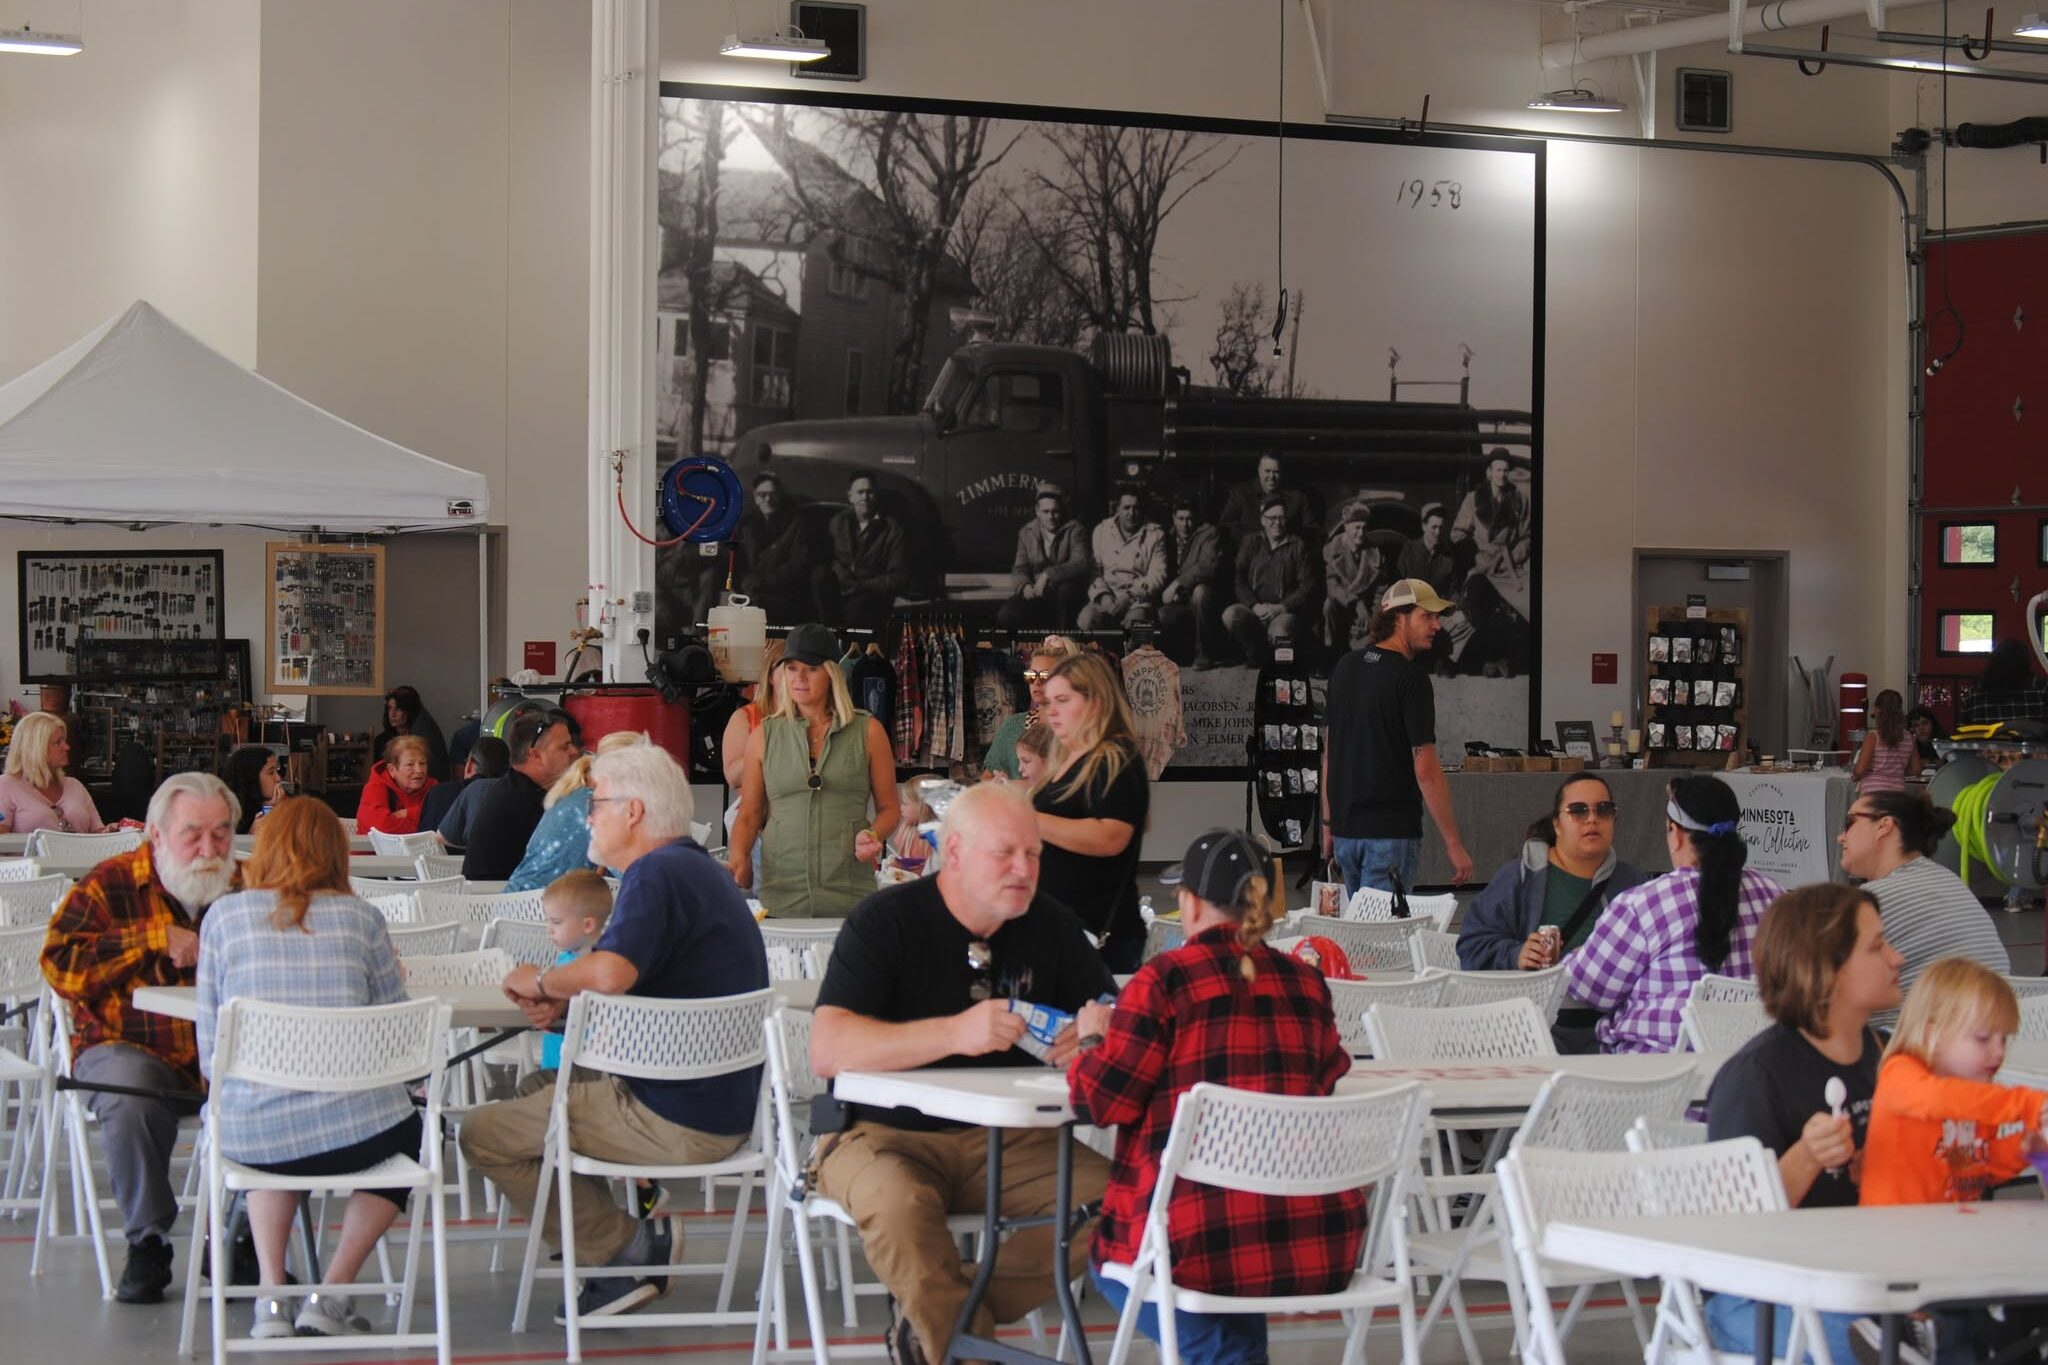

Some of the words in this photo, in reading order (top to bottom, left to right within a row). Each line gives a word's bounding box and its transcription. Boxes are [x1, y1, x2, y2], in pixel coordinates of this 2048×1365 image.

[1397, 179, 1462, 209] 1958
[1182, 701, 1239, 713] JACOBSEN
[1207, 733, 1245, 745] ELMER
[1739, 808, 1795, 825] MINNESOTA
[1763, 826, 1810, 854] Collective
